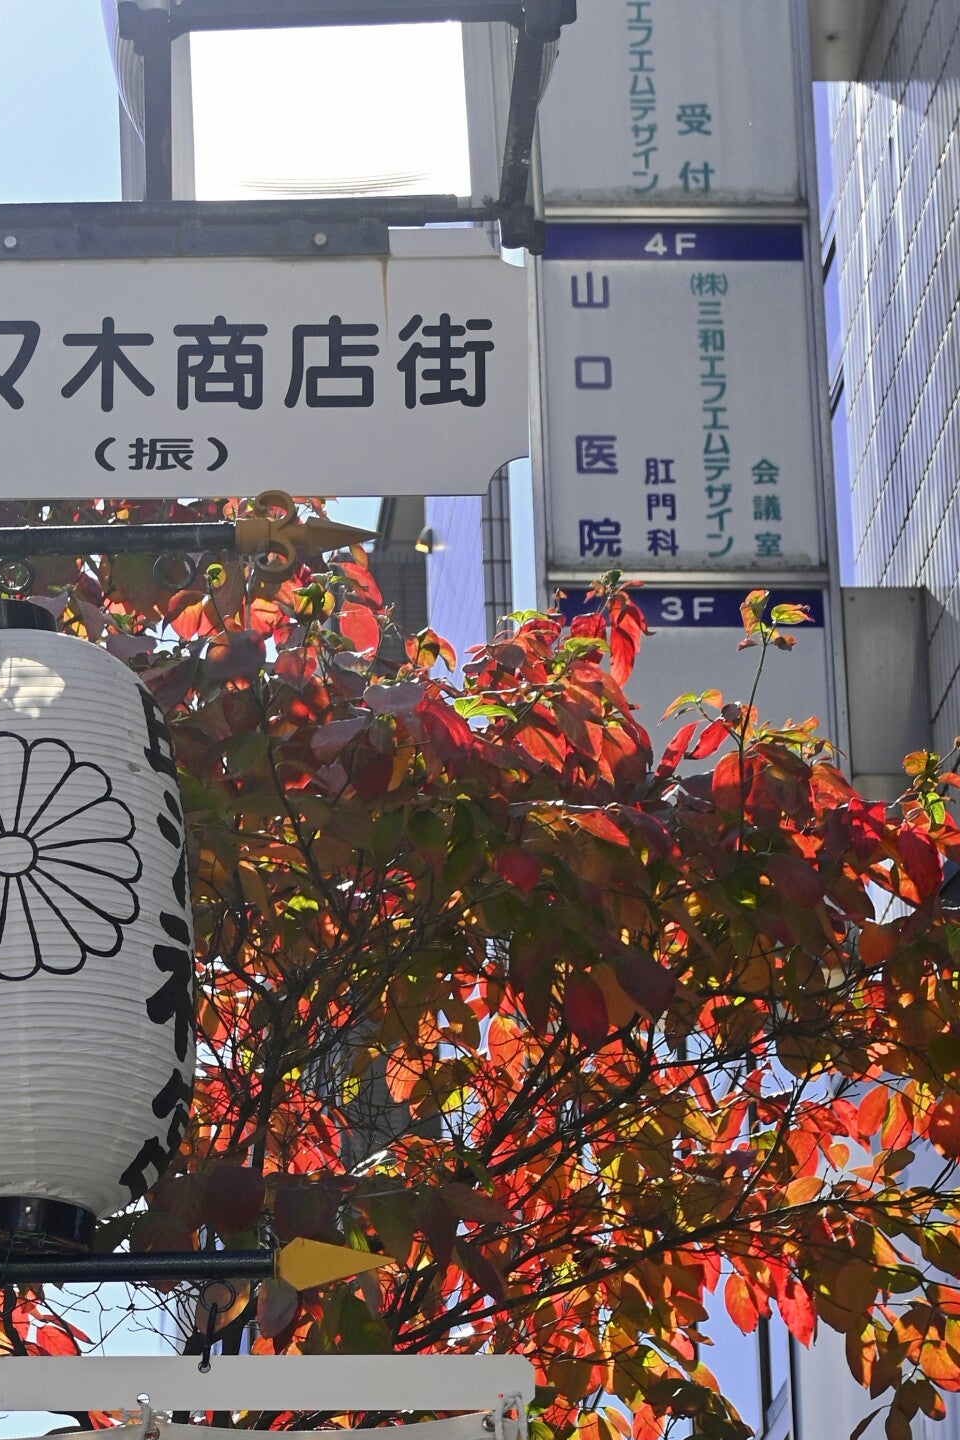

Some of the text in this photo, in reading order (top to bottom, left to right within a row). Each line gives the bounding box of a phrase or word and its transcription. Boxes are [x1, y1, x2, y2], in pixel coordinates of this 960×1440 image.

[676, 103, 715, 193] 受付
[644, 232, 696, 256] 4F
[94, 436, 228, 472] (振)
[570, 271, 623, 558] 山口医院
[644, 457, 679, 557] 肛門科
[751, 457, 784, 558] 会議室
[660, 596, 715, 621] 3F
